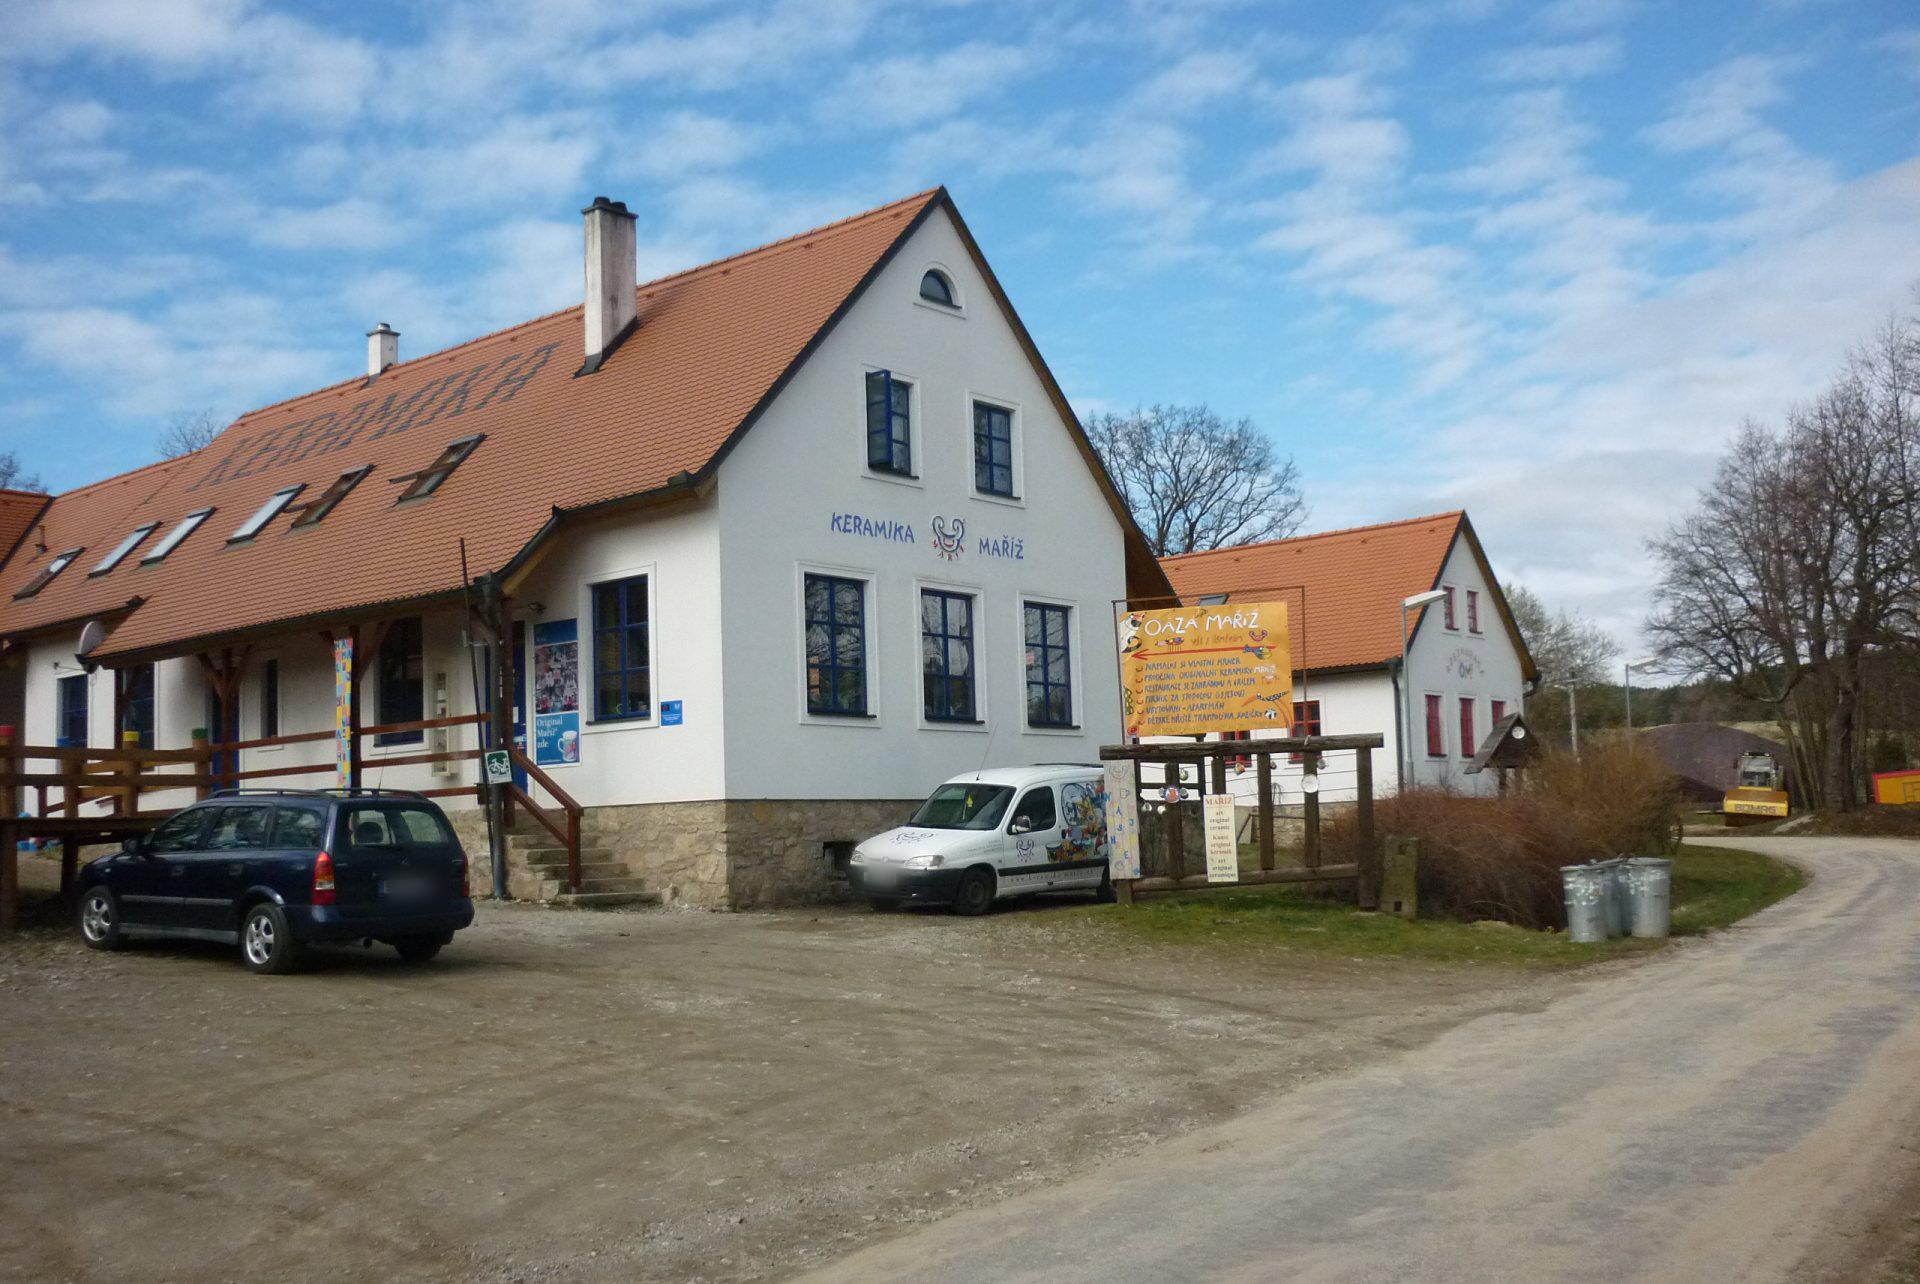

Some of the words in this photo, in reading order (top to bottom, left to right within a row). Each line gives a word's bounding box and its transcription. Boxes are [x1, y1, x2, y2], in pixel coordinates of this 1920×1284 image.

[830, 511, 916, 544] KERAMIKA
[979, 534, 1025, 560] MAŘÍŽ
[1144, 617, 1198, 636] OÁZA
[536, 715, 563, 727] Original
